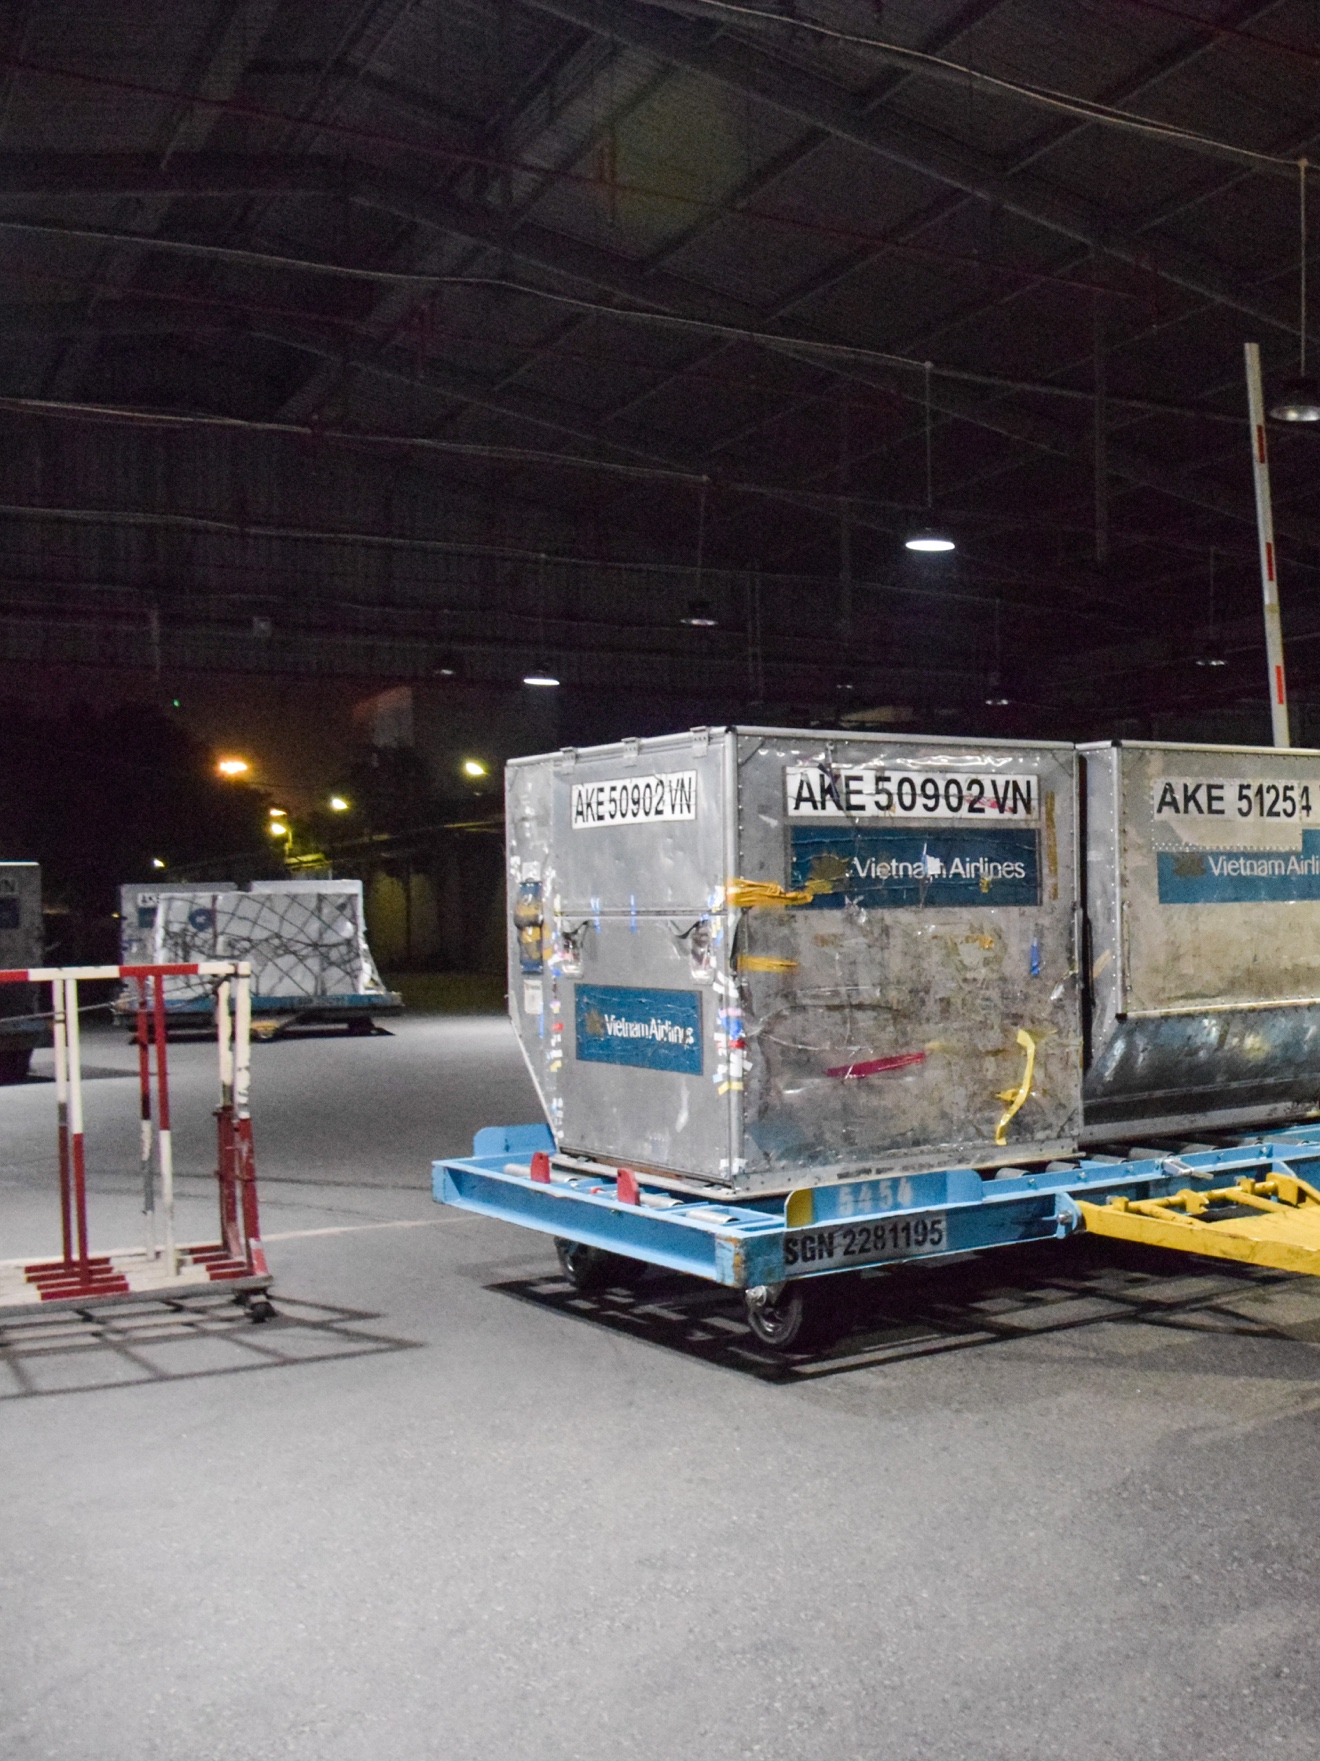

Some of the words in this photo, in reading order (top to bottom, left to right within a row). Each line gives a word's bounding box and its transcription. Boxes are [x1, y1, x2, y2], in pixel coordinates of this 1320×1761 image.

[575, 787, 605, 823] AKE
[608, 779, 665, 819] 50902
[669, 777, 692, 815] VN
[793, 772, 866, 812] AKE
[874, 776, 985, 813] 50902
[990, 779, 1032, 815] VN
[1156, 782, 1225, 815] AKE
[1237, 783, 1312, 818] 51254
[949, 856, 1026, 880] Airlines
[1208, 855, 1285, 877] Vietnam
[604, 1013, 650, 1040] Vietnam
[649, 1018, 695, 1045] Airlins
[784, 1232, 835, 1266] SGN
[842, 1218, 944, 1257] 2281195
